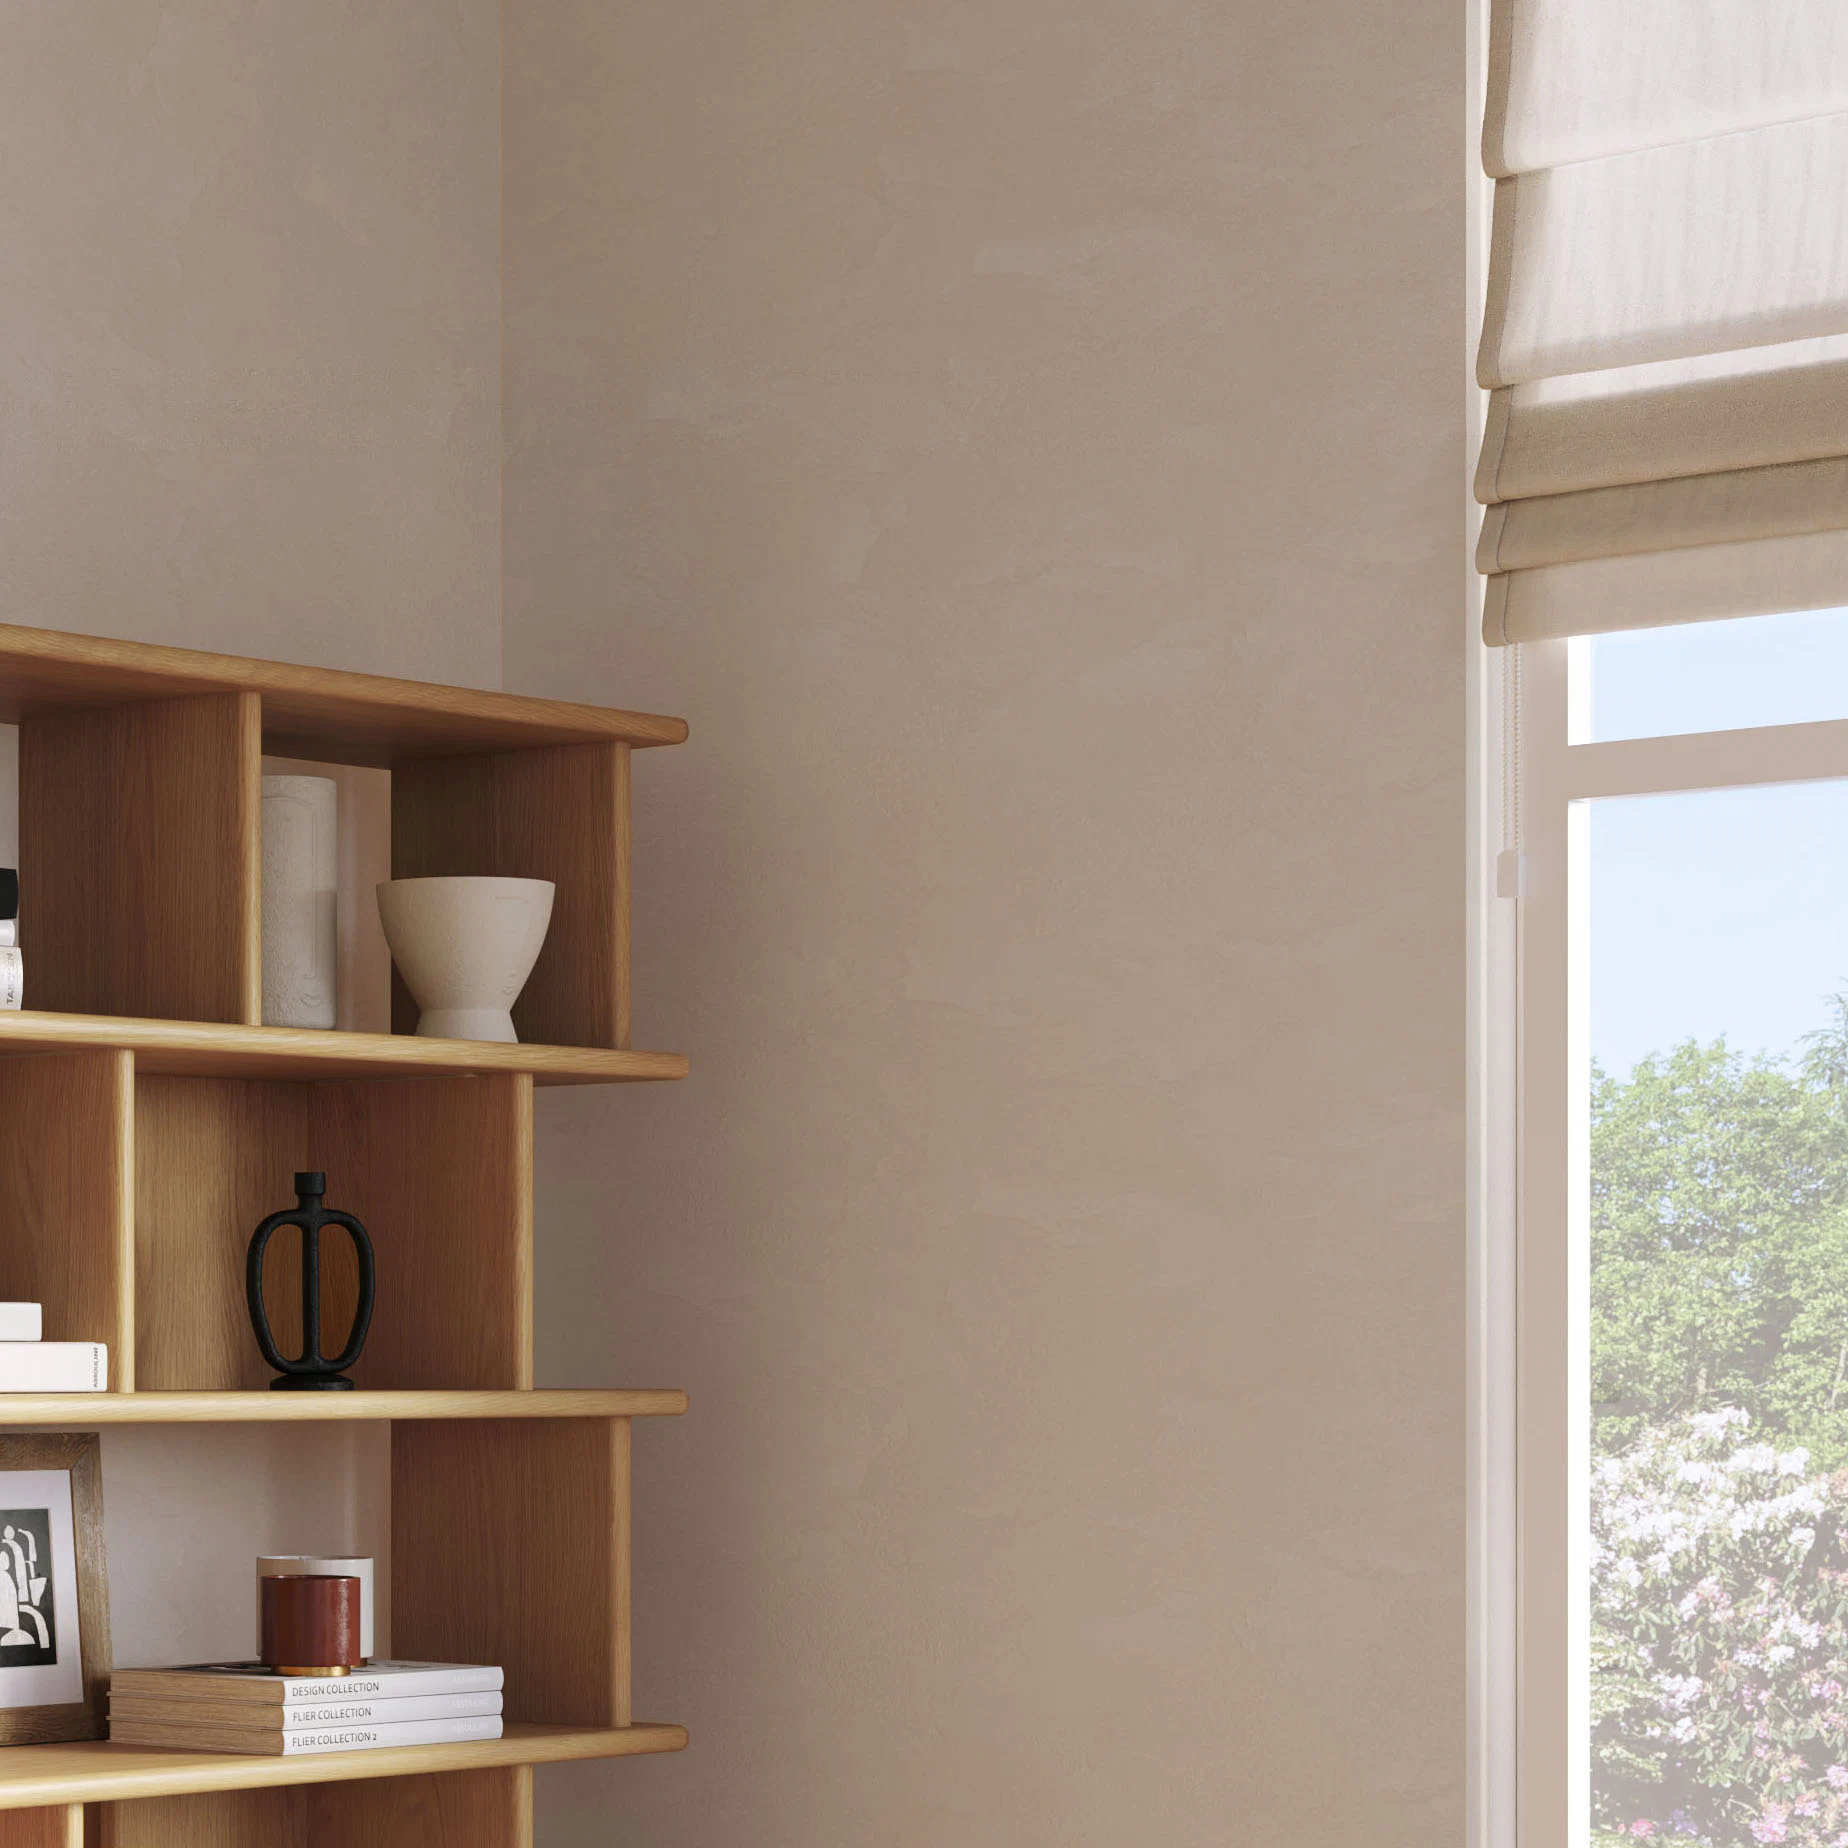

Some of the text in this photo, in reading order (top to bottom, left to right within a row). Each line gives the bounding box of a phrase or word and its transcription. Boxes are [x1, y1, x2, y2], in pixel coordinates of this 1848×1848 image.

[292, 1681, 379, 1697] DESIGN COLLECTION
[293, 1707, 371, 1721] FLIER COLLECTION
[292, 1732, 377, 1747] FLIER COLLECTION 2
